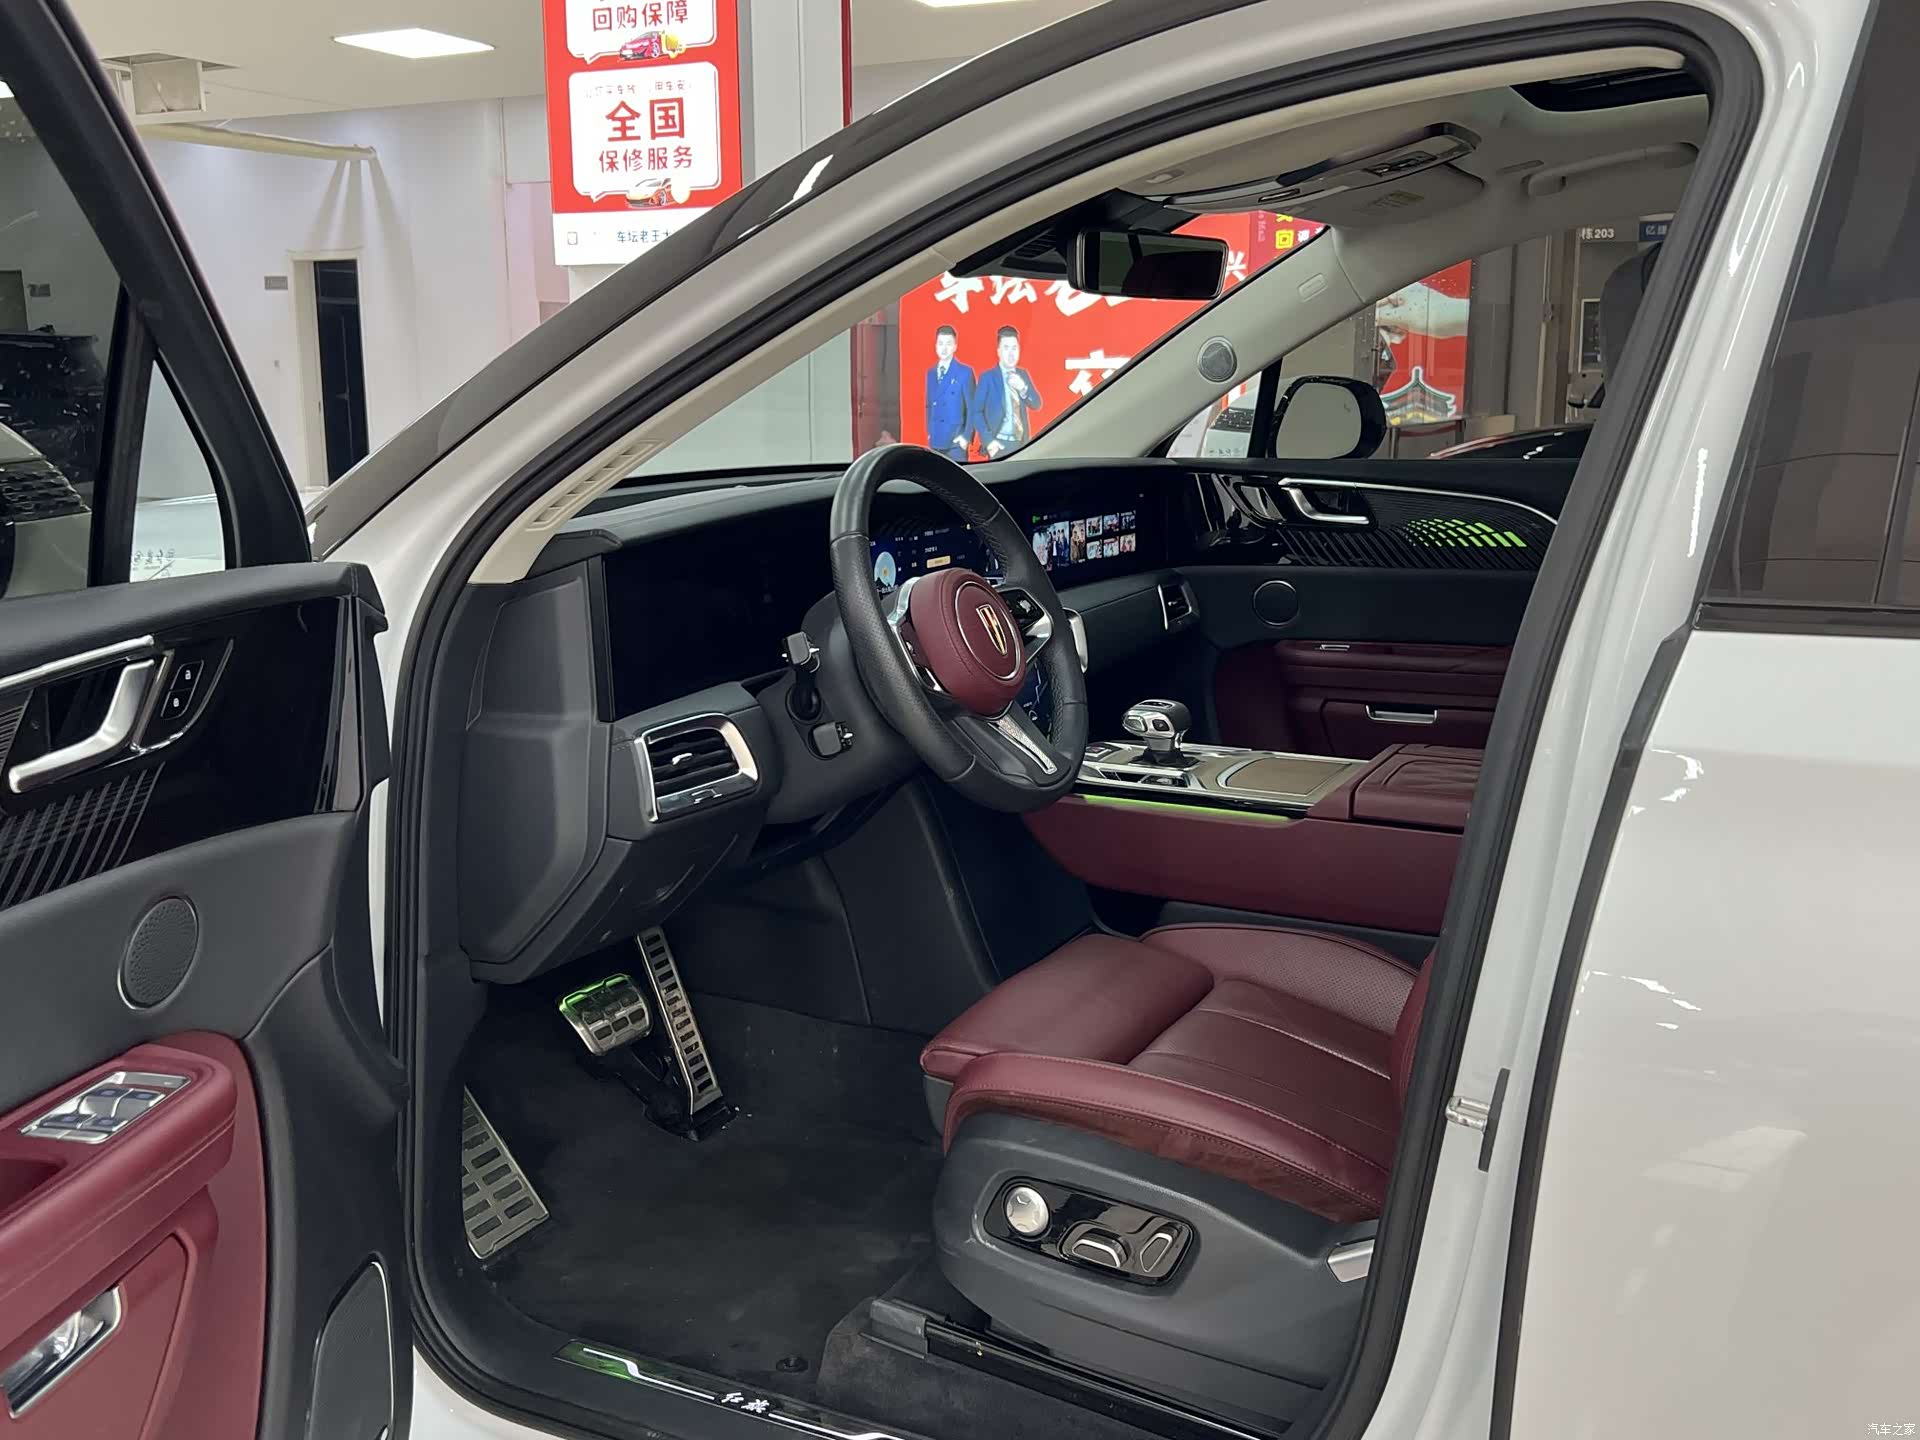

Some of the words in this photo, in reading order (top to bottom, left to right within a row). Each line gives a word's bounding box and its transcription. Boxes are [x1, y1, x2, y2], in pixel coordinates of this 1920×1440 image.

[593, 0, 688, 31] 回购保障
[605, 97, 685, 142] 全国
[599, 146, 693, 173] 保修服务
